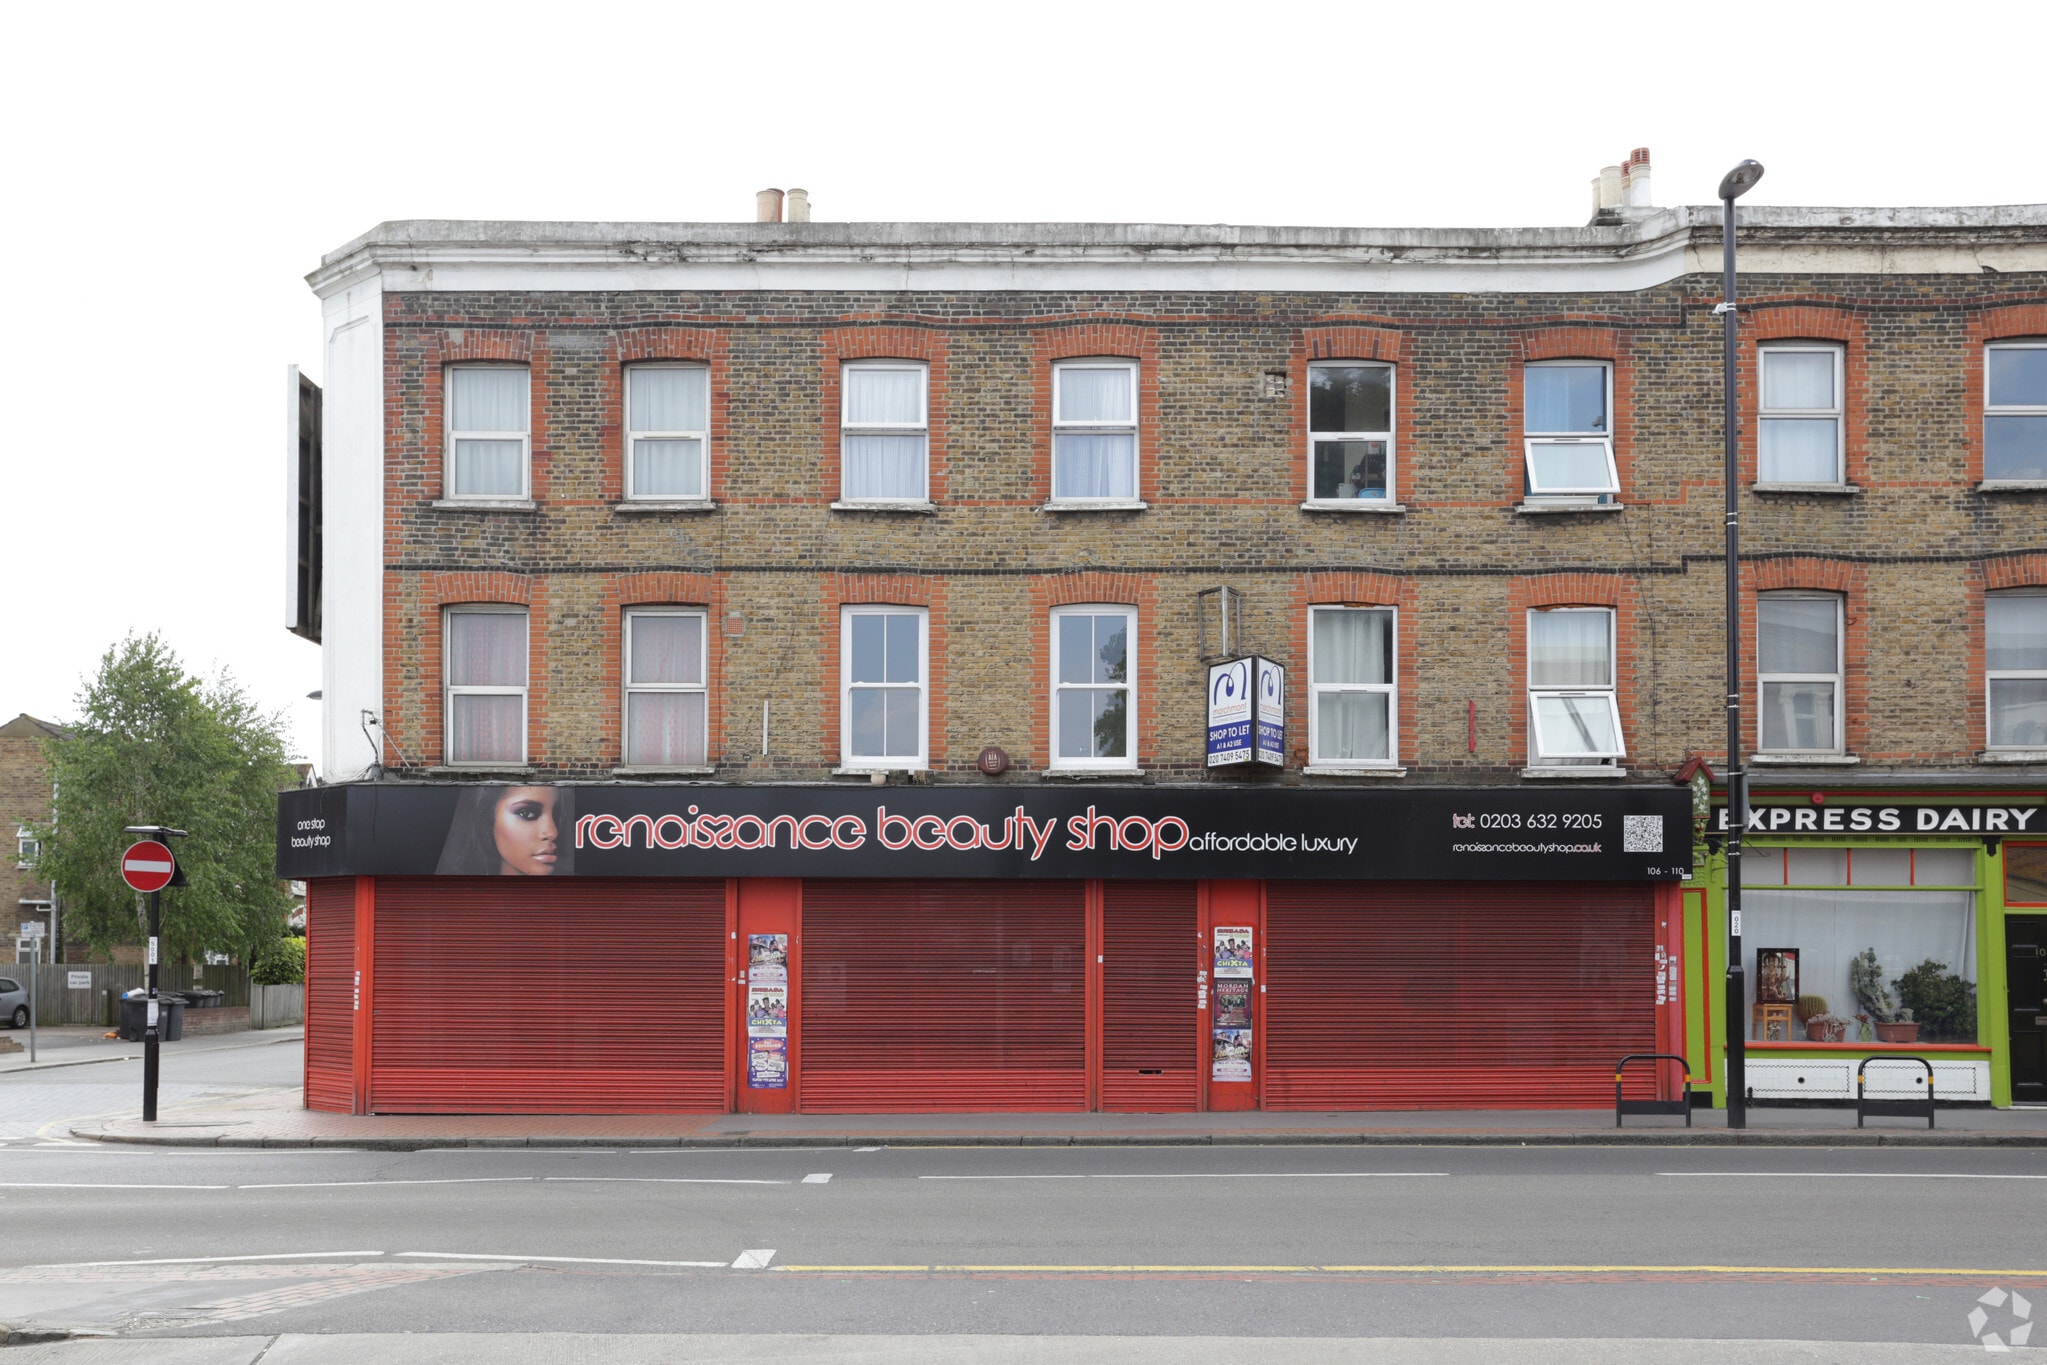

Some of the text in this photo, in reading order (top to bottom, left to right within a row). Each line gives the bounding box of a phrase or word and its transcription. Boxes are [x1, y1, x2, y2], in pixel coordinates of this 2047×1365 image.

[1209, 724, 1250, 741] SHOP TO LET
[1270, 727, 1277, 739] TO
[297, 817, 326, 831] one stop
[1453, 813, 1603, 829] tel: 0203 632 9205
[1917, 808, 2038, 831] DAIRY
[575, 804, 1359, 861] renaissance beauty shop affordable luxury
[291, 834, 331, 849] beauty shop
[1453, 841, 1602, 854] renaissancebeautyshop.co.uk
[1647, 867, 1662, 876] 106
[1671, 867, 1685, 876] 110
